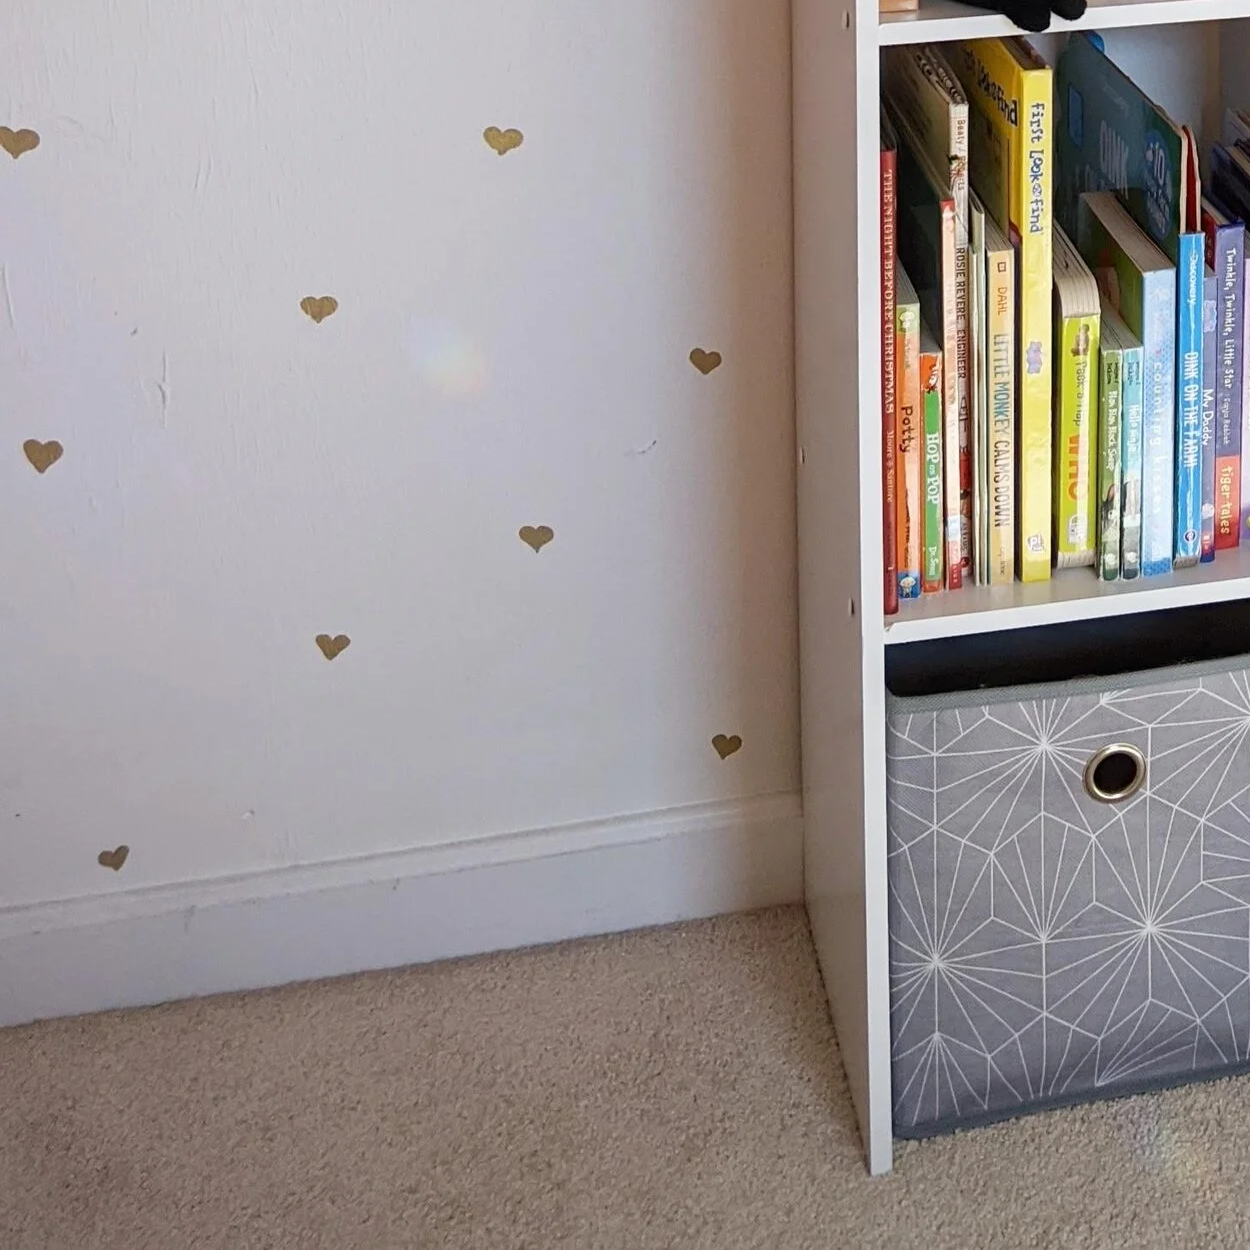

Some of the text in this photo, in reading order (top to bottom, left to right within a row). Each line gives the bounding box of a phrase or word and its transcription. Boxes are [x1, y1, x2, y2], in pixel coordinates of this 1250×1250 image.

[955, 119, 966, 145] Beaty
[883, 168, 894, 203] THE
[883, 204, 894, 258] NIGHT
[1030, 198, 1045, 234] find
[956, 247, 967, 278] ROSIE
[1223, 247, 1237, 291] Twinkle,
[883, 260, 894, 321] BEFORE
[997, 286, 1009, 316] DAHL
[1223, 293, 1237, 336] Twinkle,
[884, 323, 895, 414] CHRISTMAS
[956, 329, 968, 379] ENGINEER
[993, 333, 1011, 378] LITTLE
[1183, 351, 1199, 380] OINK
[1223, 338, 1236, 365] Little
[1184, 384, 1199, 401] ON
[1223, 368, 1235, 389] Star
[993, 381, 1011, 435] MONKEY
[1183, 406, 1199, 427] THE
[1201, 389, 1215, 446] My Daddy
[885, 429, 894, 459] Moore
[899, 405, 915, 454] Potty
[926, 431, 940, 462] HOP
[1150, 361, 1168, 514] counting kisses
[993, 440, 1011, 484] CALMS
[926, 475, 940, 506] POP
[993, 485, 1011, 529] DOWN
[1219, 500, 1234, 535] tales
